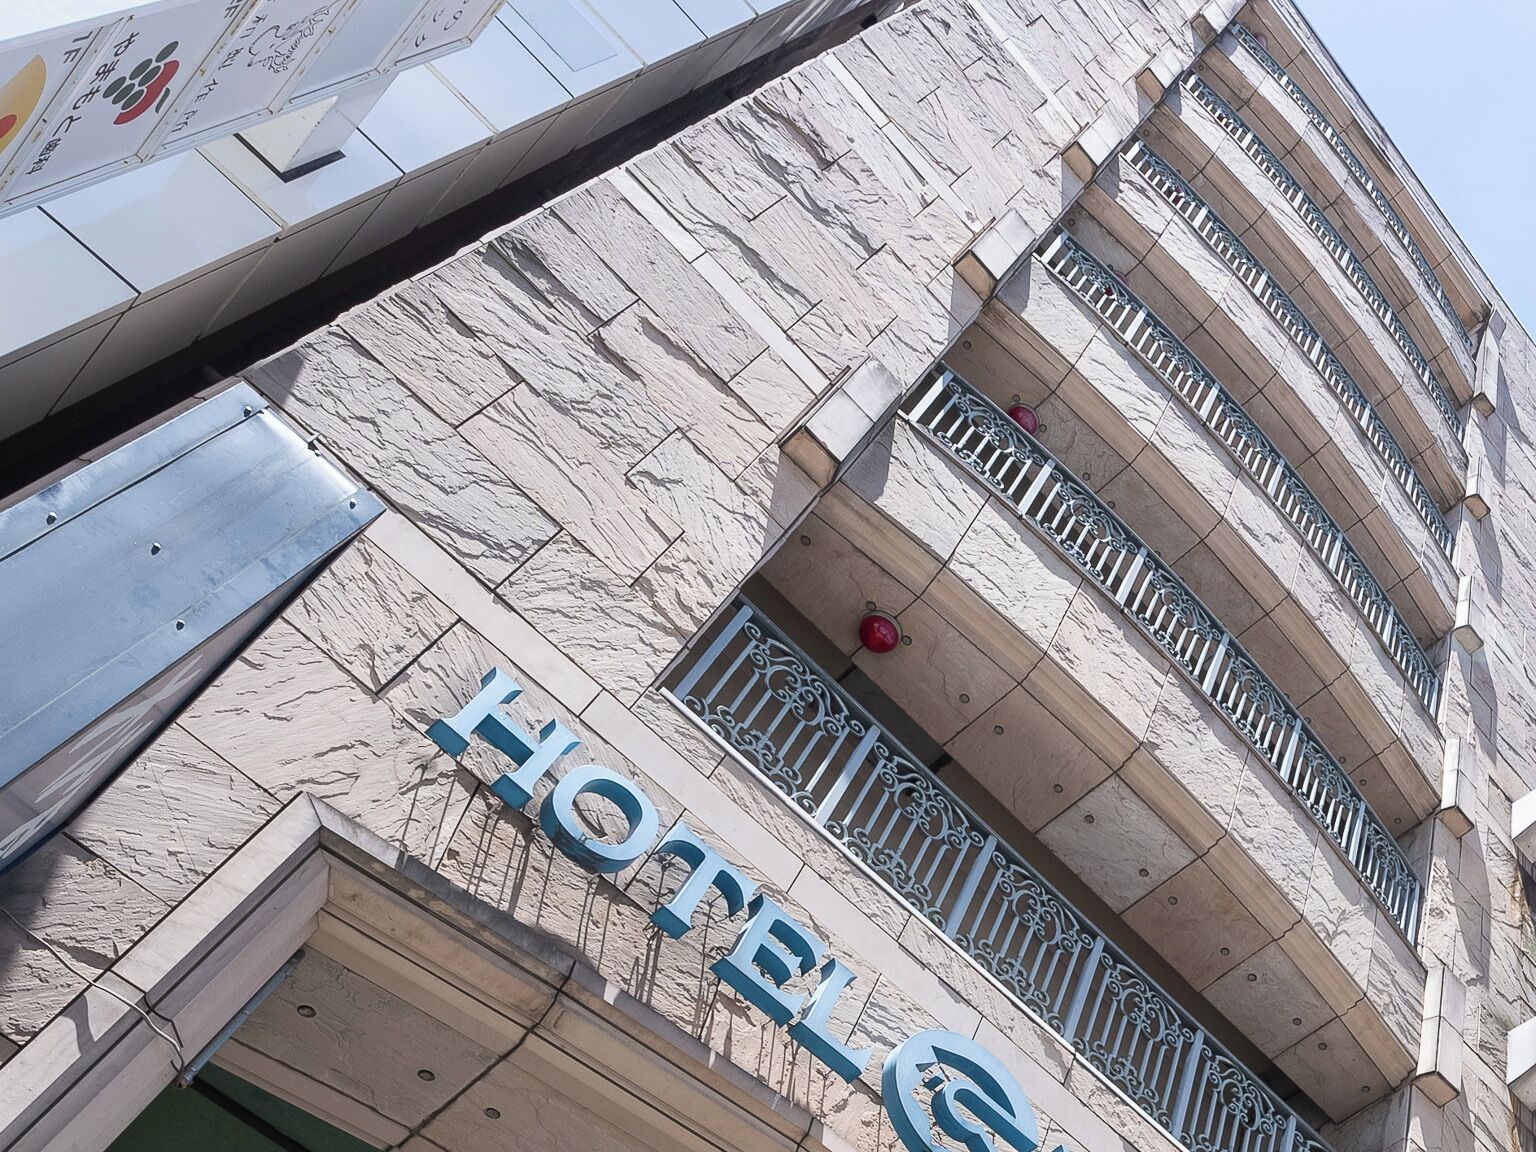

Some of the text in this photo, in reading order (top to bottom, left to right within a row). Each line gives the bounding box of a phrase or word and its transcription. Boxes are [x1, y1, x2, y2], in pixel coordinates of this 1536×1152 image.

[63, 31, 94, 64] 1F
[172, 0, 277, 134] 和製作所
[223, 0, 243, 19] F
[25, 32, 140, 176] やまもと歯科
[425, 666, 873, 1085] HOTEL
